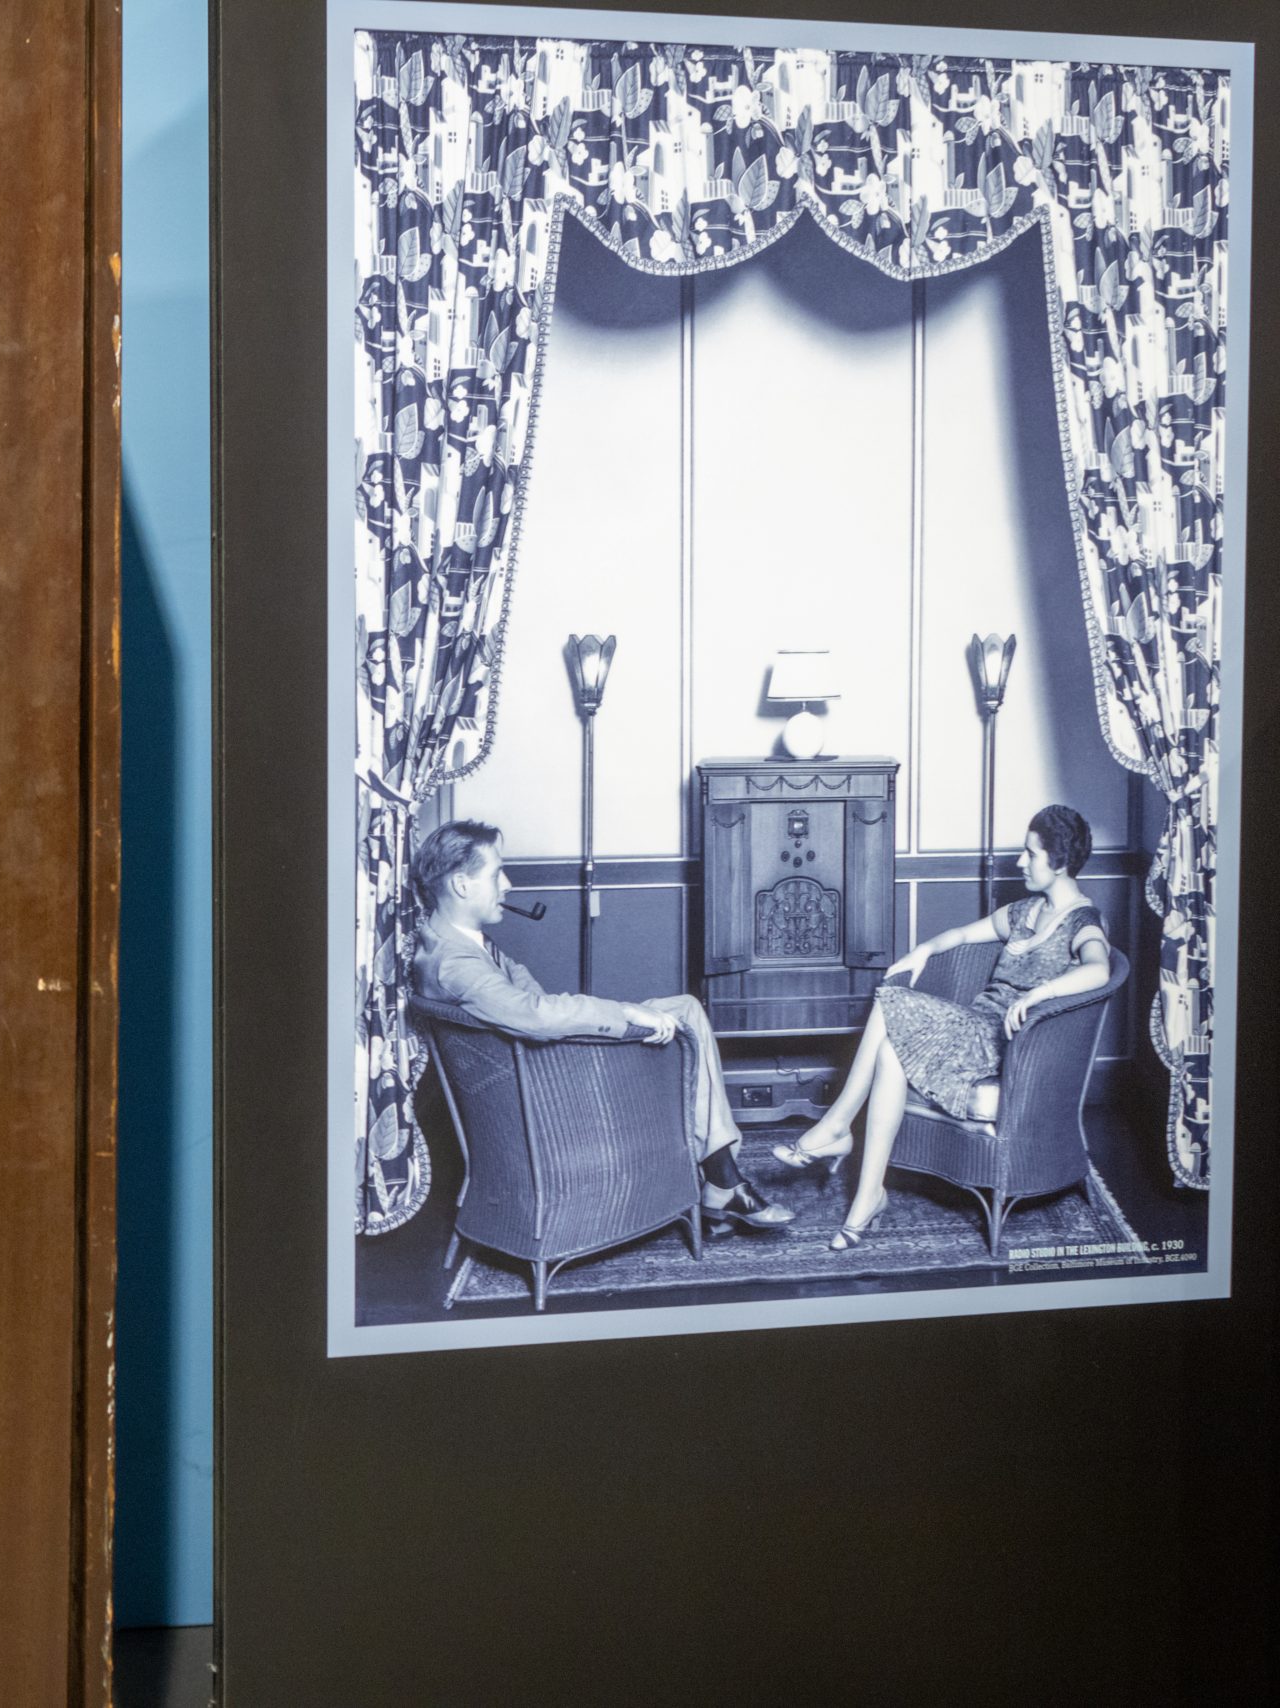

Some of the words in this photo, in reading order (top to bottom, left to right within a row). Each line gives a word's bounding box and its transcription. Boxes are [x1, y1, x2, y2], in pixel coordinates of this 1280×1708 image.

[1008, 1249, 1031, 1260] RADIO
[1031, 1246, 1056, 1258] STUDIO
[1056, 1246, 1065, 1257] IN
[1065, 1245, 1079, 1256] THE
[1079, 1243, 1116, 1255] LEXINGTON
[1151, 1243, 1160, 1251] c.
[1161, 1239, 1184, 1250] 1930
[1009, 1263, 1024, 1273] BGE
[1061, 1260, 1095, 1269] Baltimore
[1095, 1258, 1125, 1267] Museum
[1125, 1256, 1134, 1265] of
